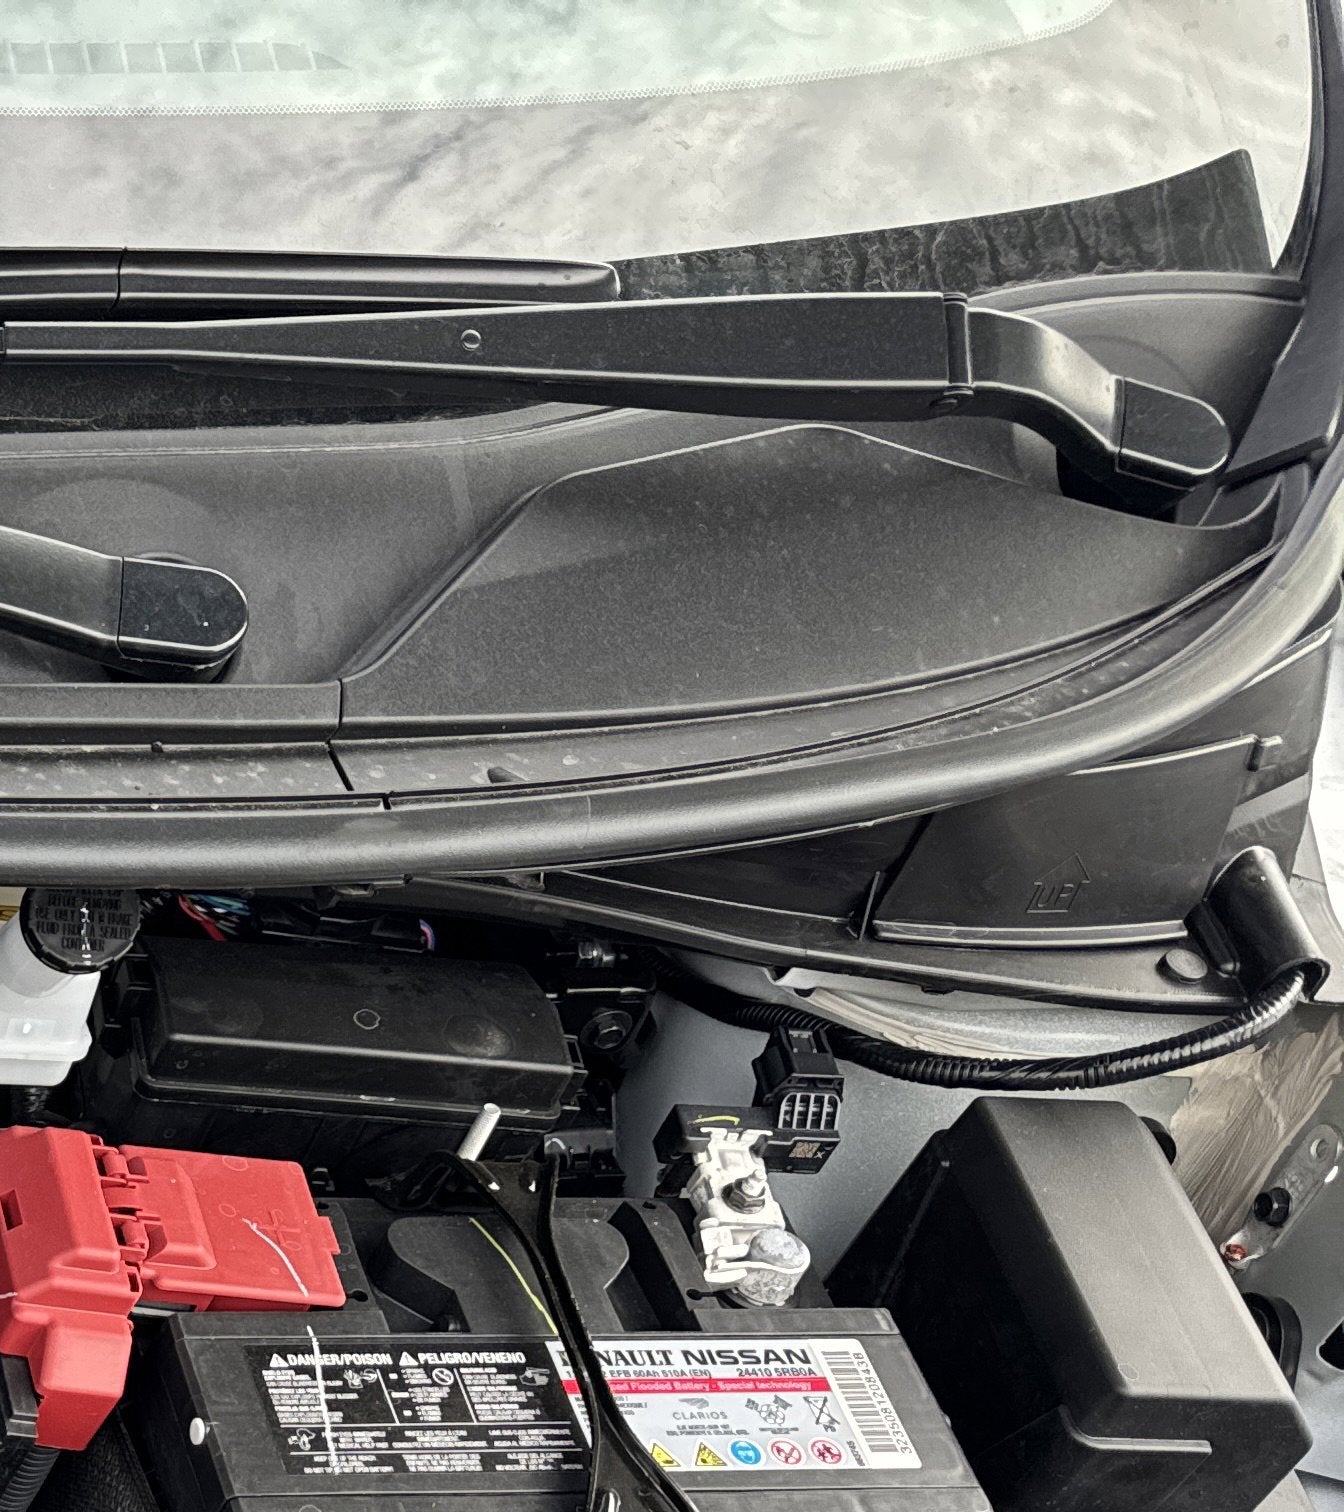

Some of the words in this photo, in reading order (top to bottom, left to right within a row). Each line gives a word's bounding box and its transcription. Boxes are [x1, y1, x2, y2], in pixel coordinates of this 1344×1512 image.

[287, 1353, 393, 1367] DANGER/POISON
[418, 1352, 526, 1365] PELIGRO/VENENO
[681, 1348, 812, 1366] NISSAN
[736, 1367, 773, 1378] 24410
[631, 1380, 672, 1392] Flooded
[673, 1380, 710, 1393] Battery
[717, 1380, 750, 1392] Special
[751, 1380, 812, 1393] technology
[672, 1410, 729, 1422] CLARIOS
